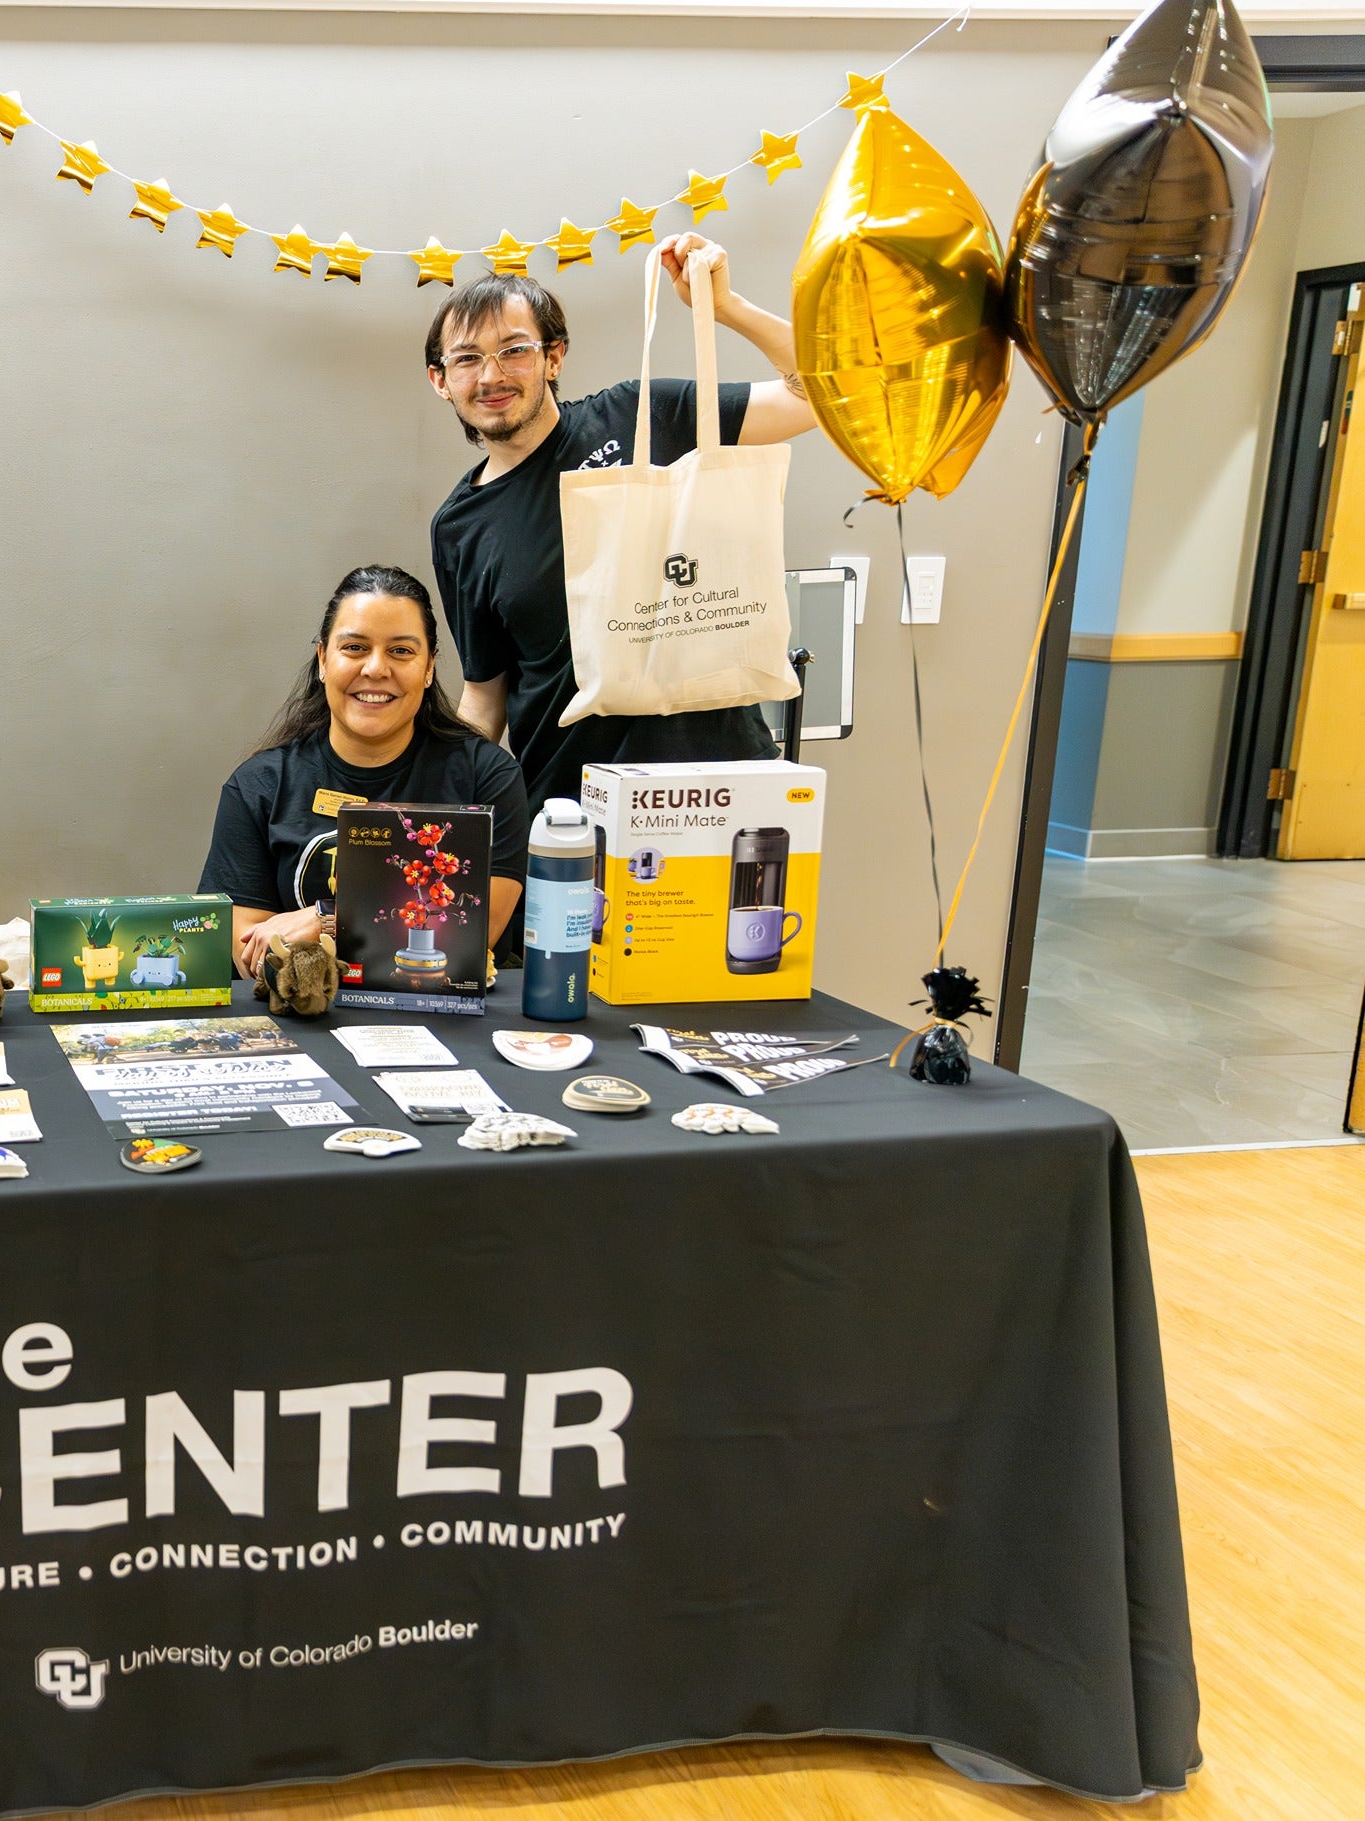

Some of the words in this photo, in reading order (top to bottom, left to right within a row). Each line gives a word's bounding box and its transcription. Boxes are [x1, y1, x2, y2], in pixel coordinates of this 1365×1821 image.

[635, 598, 668, 615] Center
[673, 595, 689, 607] for
[692, 587, 739, 604] Cultural
[607, 613, 680, 631] Connections
[684, 611, 693, 622] &
[696, 601, 767, 620] Community
[665, 631, 674, 639] OF
[675, 625, 714, 637] COLORADO
[715, 620, 750, 631] BOULDER
[632, 788, 731, 810] KEURIG
[791, 791, 811, 800] NEW
[642, 890, 656, 898] tiny
[649, 899, 661, 907] big
[173, 916, 199, 932] Happy
[43, 973, 60, 982] LEGO
[41, 998, 93, 1007] BOTANICALS
[341, 993, 395, 1005] BOTANICALS
[710, 1031, 797, 1046] PROUD
[721, 1044, 807, 1063] PROUD
[763, 1058, 847, 1081] PROUD
[108, 1085, 234, 1097] SATURDAY,
[237, 1082, 293, 1091] NOV.
[120, 1109, 198, 1119] REGISTER
[110, 1536, 358, 1578] CONNECTION
[399, 1513, 628, 1551] COMMUNITY
[120, 1644, 233, 1675] University
[239, 1646, 263, 1670] of
[269, 1634, 373, 1667] Colorado
[378, 1619, 479, 1649] Boulder
